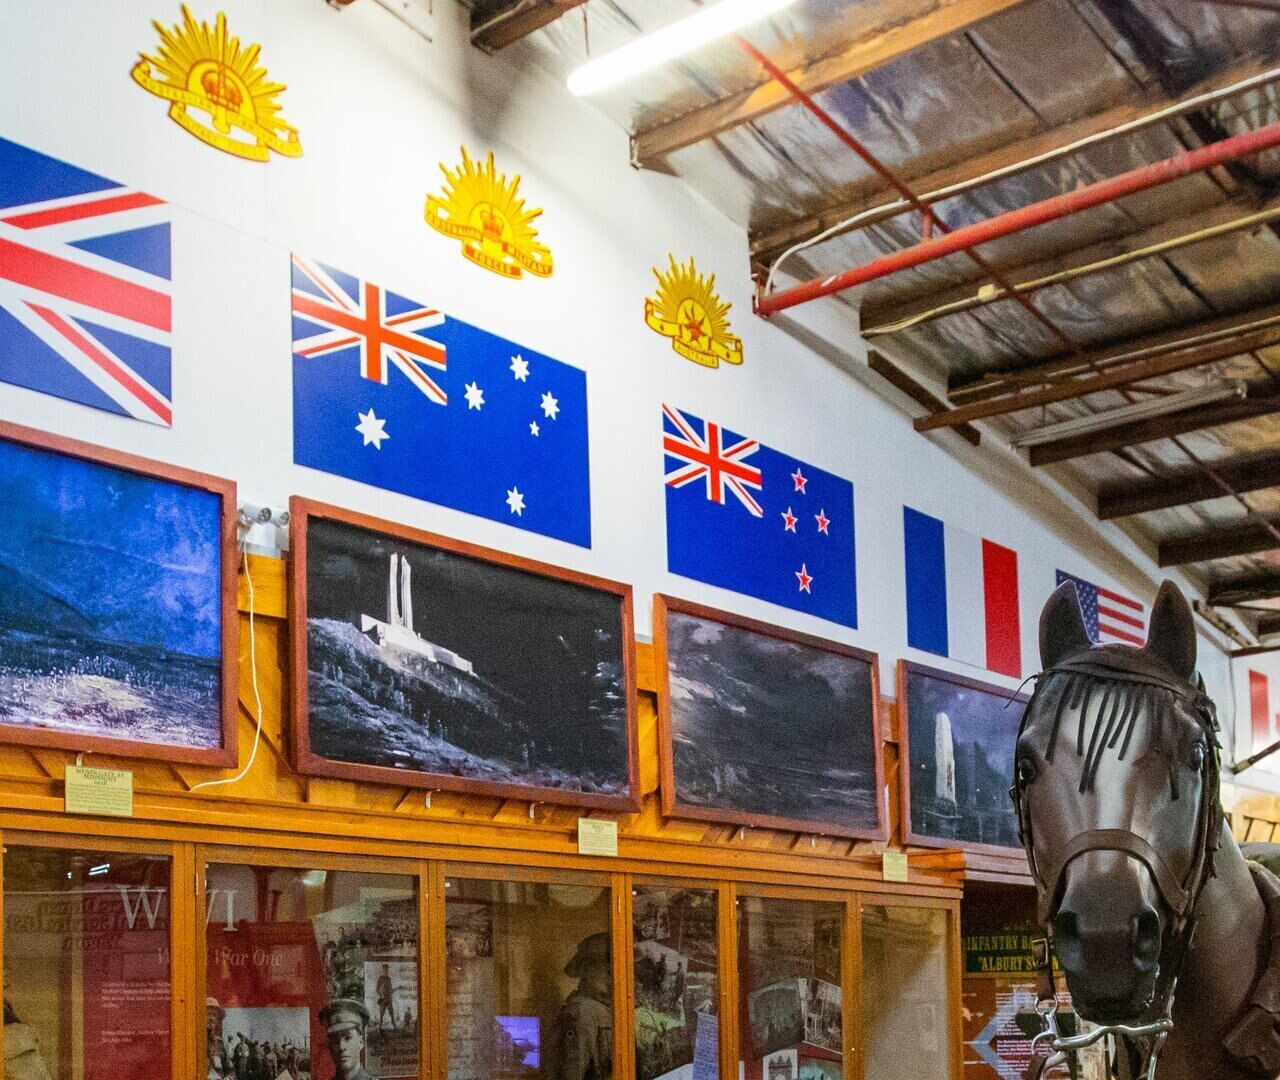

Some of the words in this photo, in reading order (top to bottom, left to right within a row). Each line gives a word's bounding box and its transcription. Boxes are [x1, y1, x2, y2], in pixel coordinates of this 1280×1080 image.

[473, 250, 512, 275] FORCES
[966, 935, 1019, 951] INFANTRY
[214, 948, 249, 967] War
[252, 948, 284, 967] One
